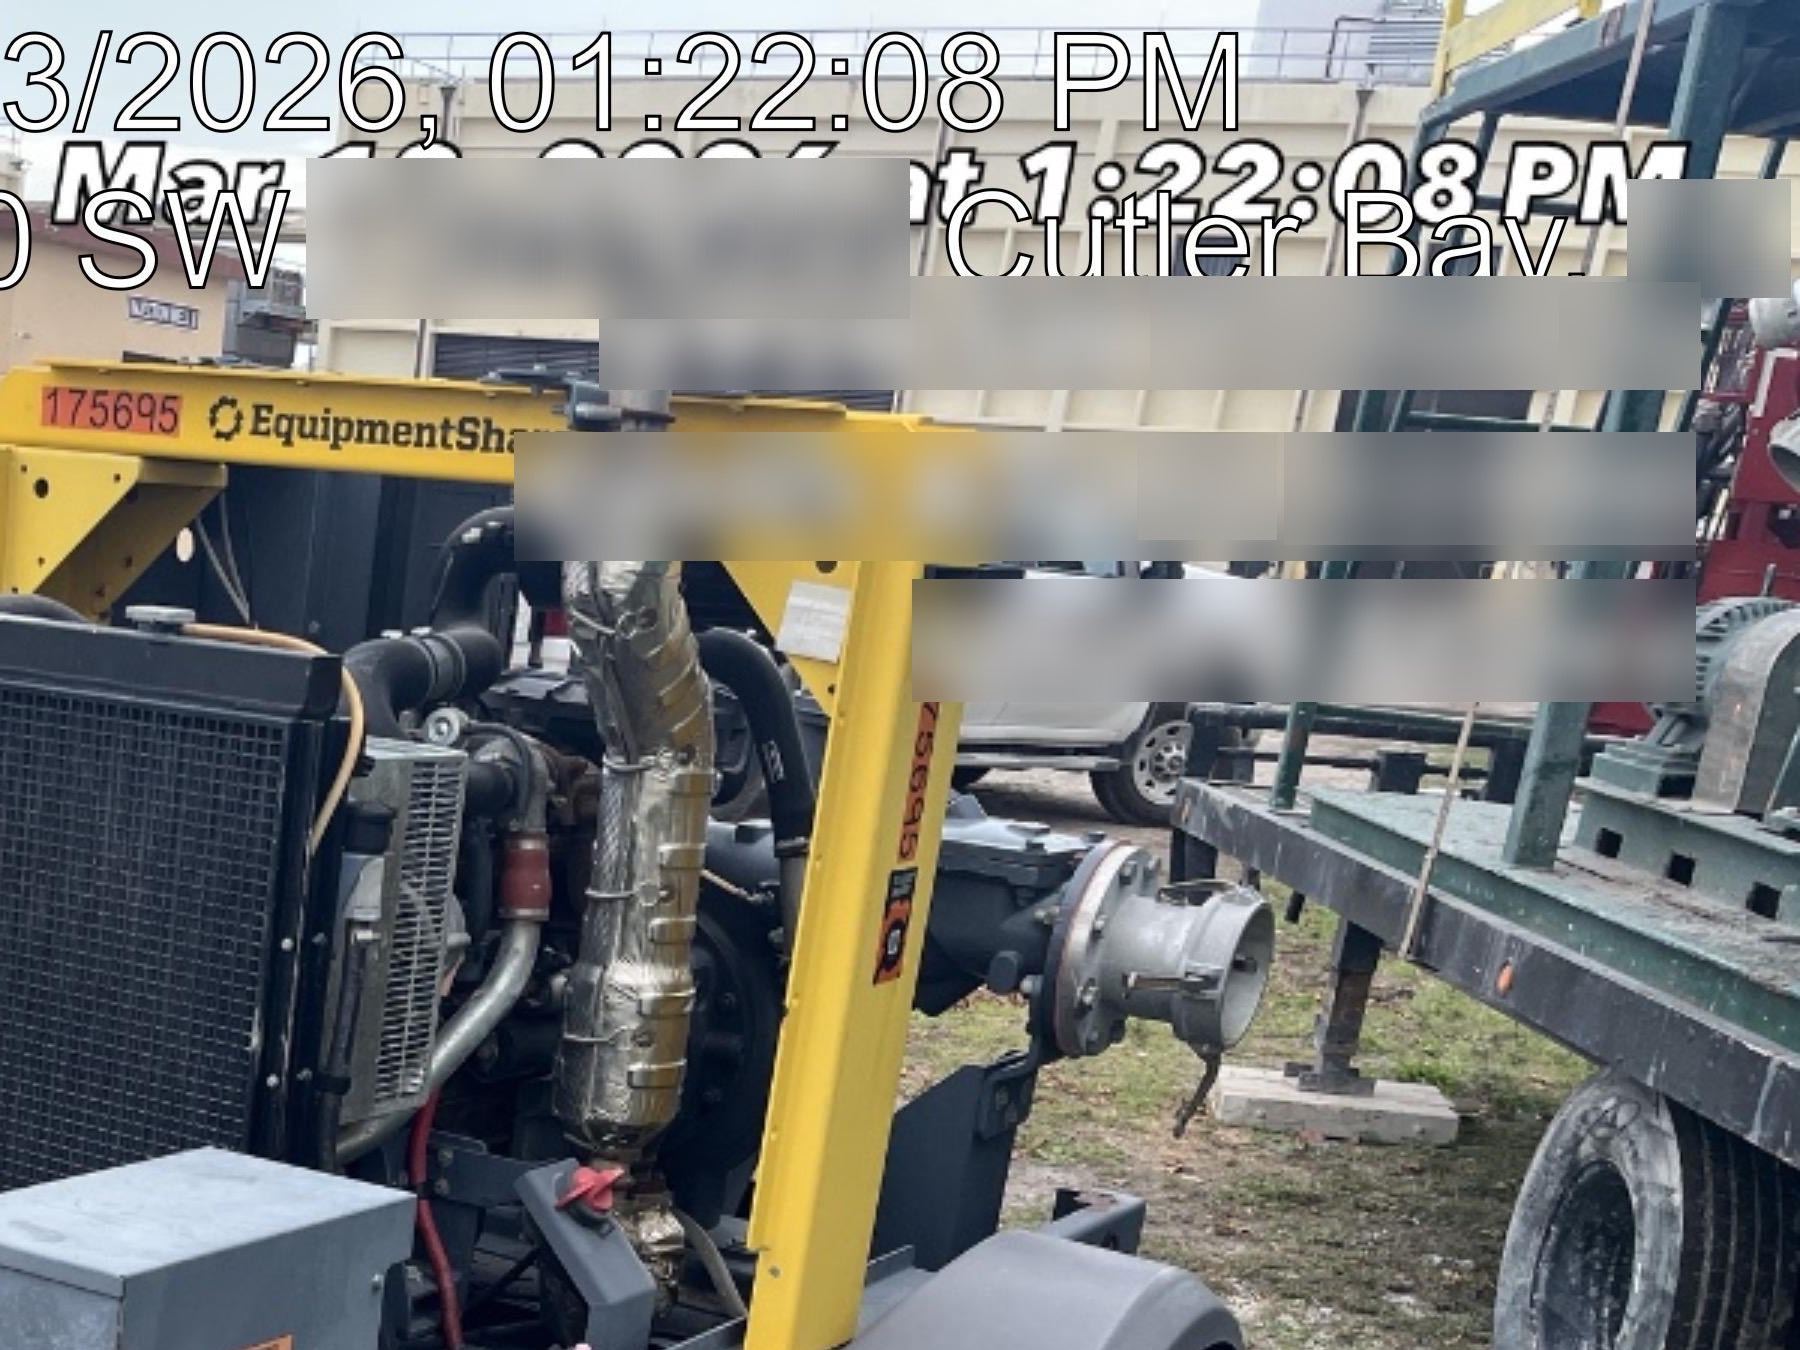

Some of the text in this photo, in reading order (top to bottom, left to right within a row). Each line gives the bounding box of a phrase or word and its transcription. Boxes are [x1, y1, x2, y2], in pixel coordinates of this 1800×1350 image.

[47, 387, 179, 433] 175695
[250, 404, 560, 454] EquipmentSh
[900, 702, 940, 859] 75695
